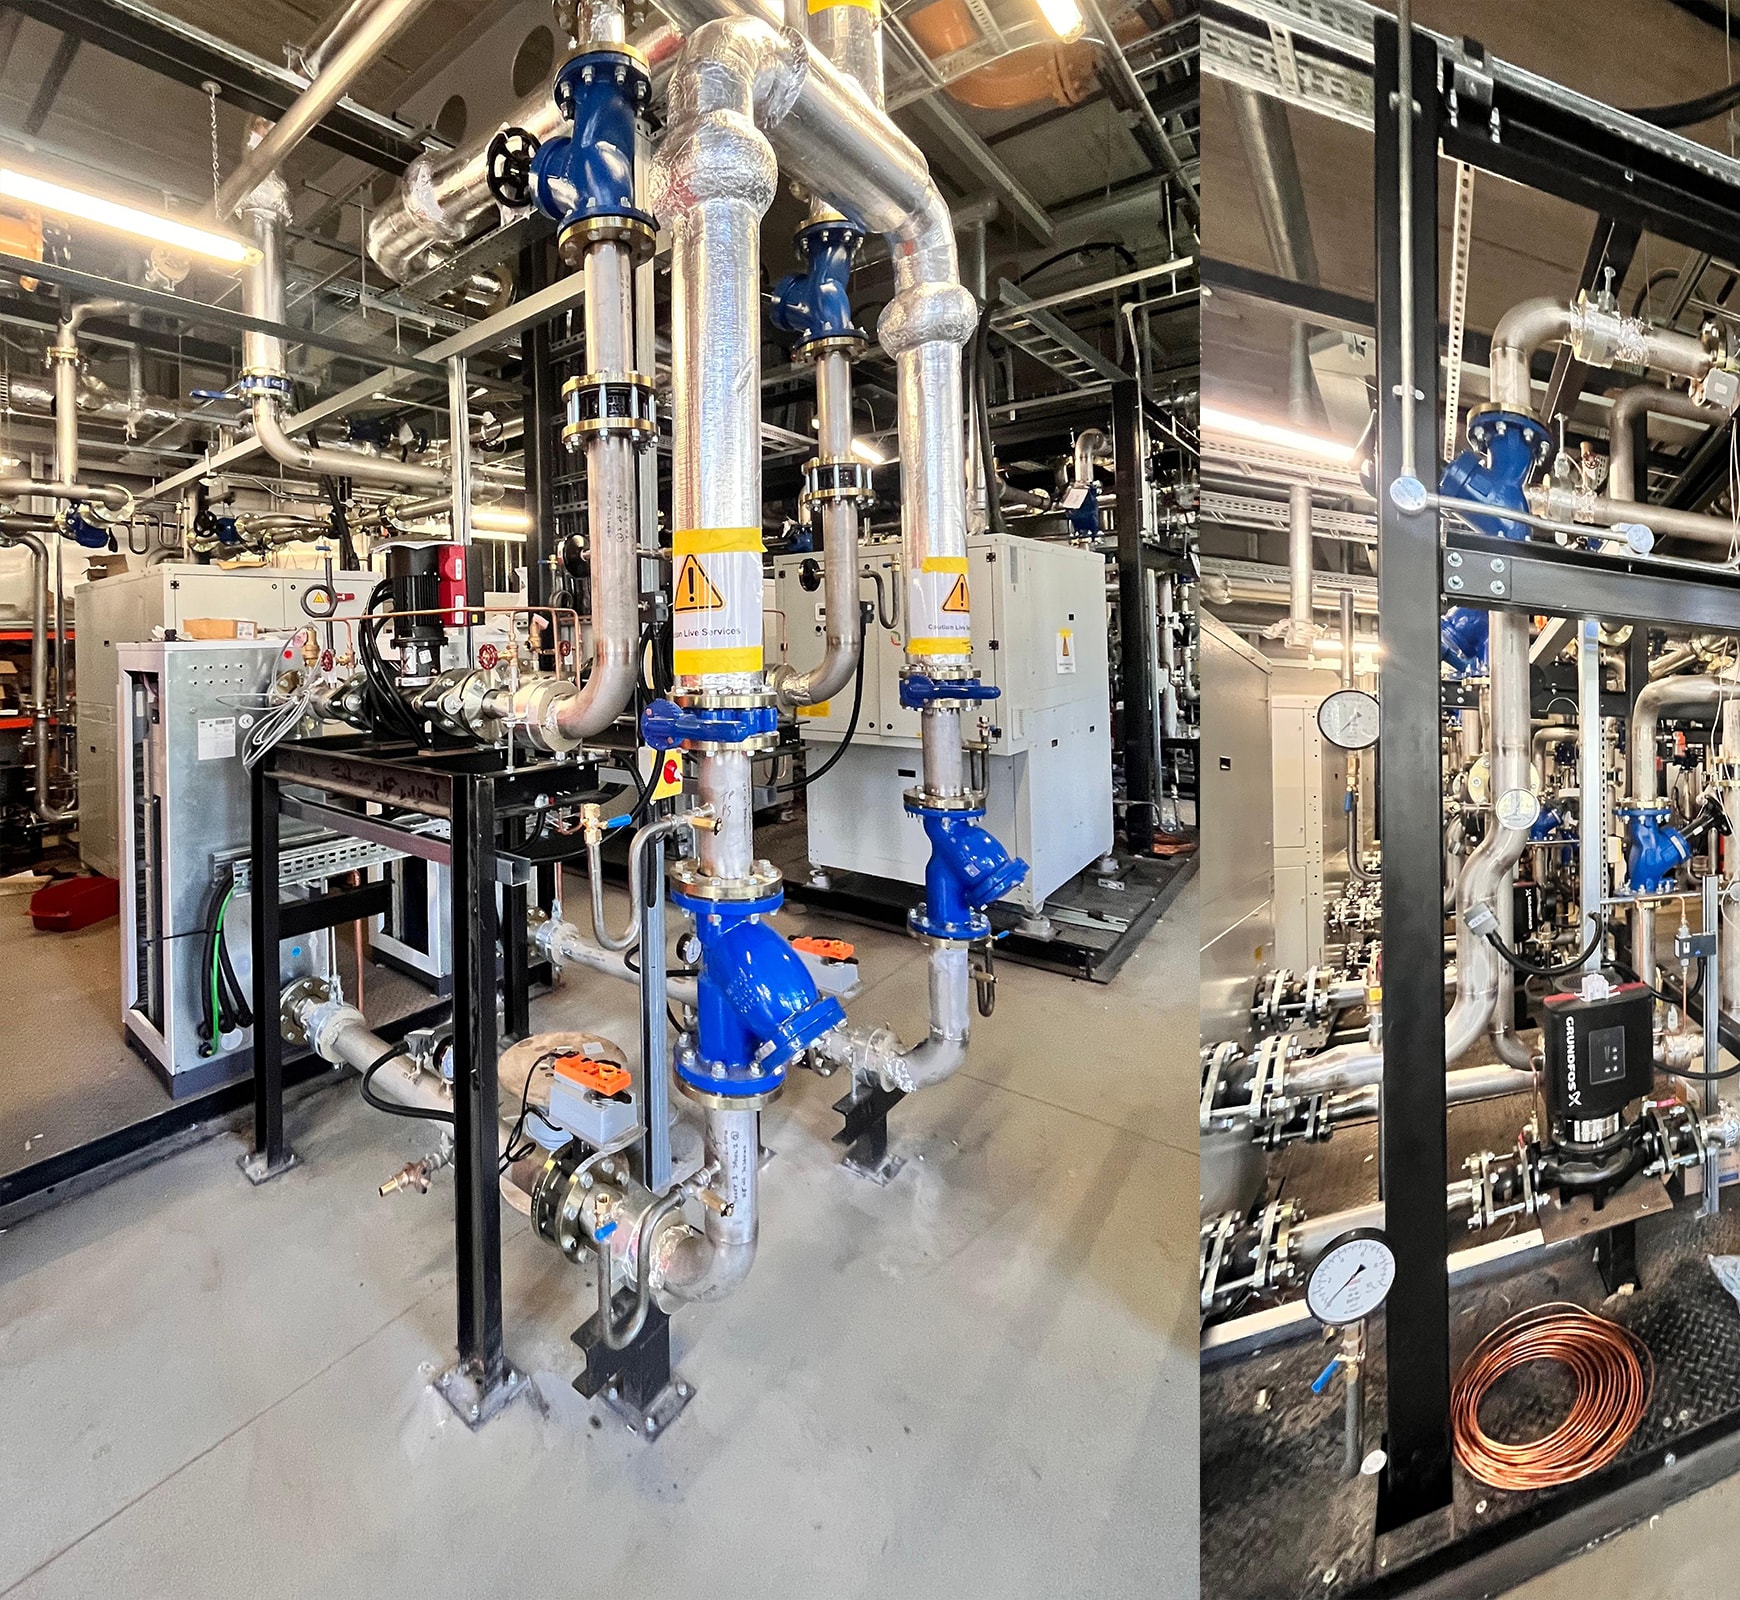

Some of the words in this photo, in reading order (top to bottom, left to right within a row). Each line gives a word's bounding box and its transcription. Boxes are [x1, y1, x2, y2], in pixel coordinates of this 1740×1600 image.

[684, 629, 699, 638] Live
[702, 627, 741, 636] Services
[1565, 1015, 1577, 1092] GRUNDFOS
